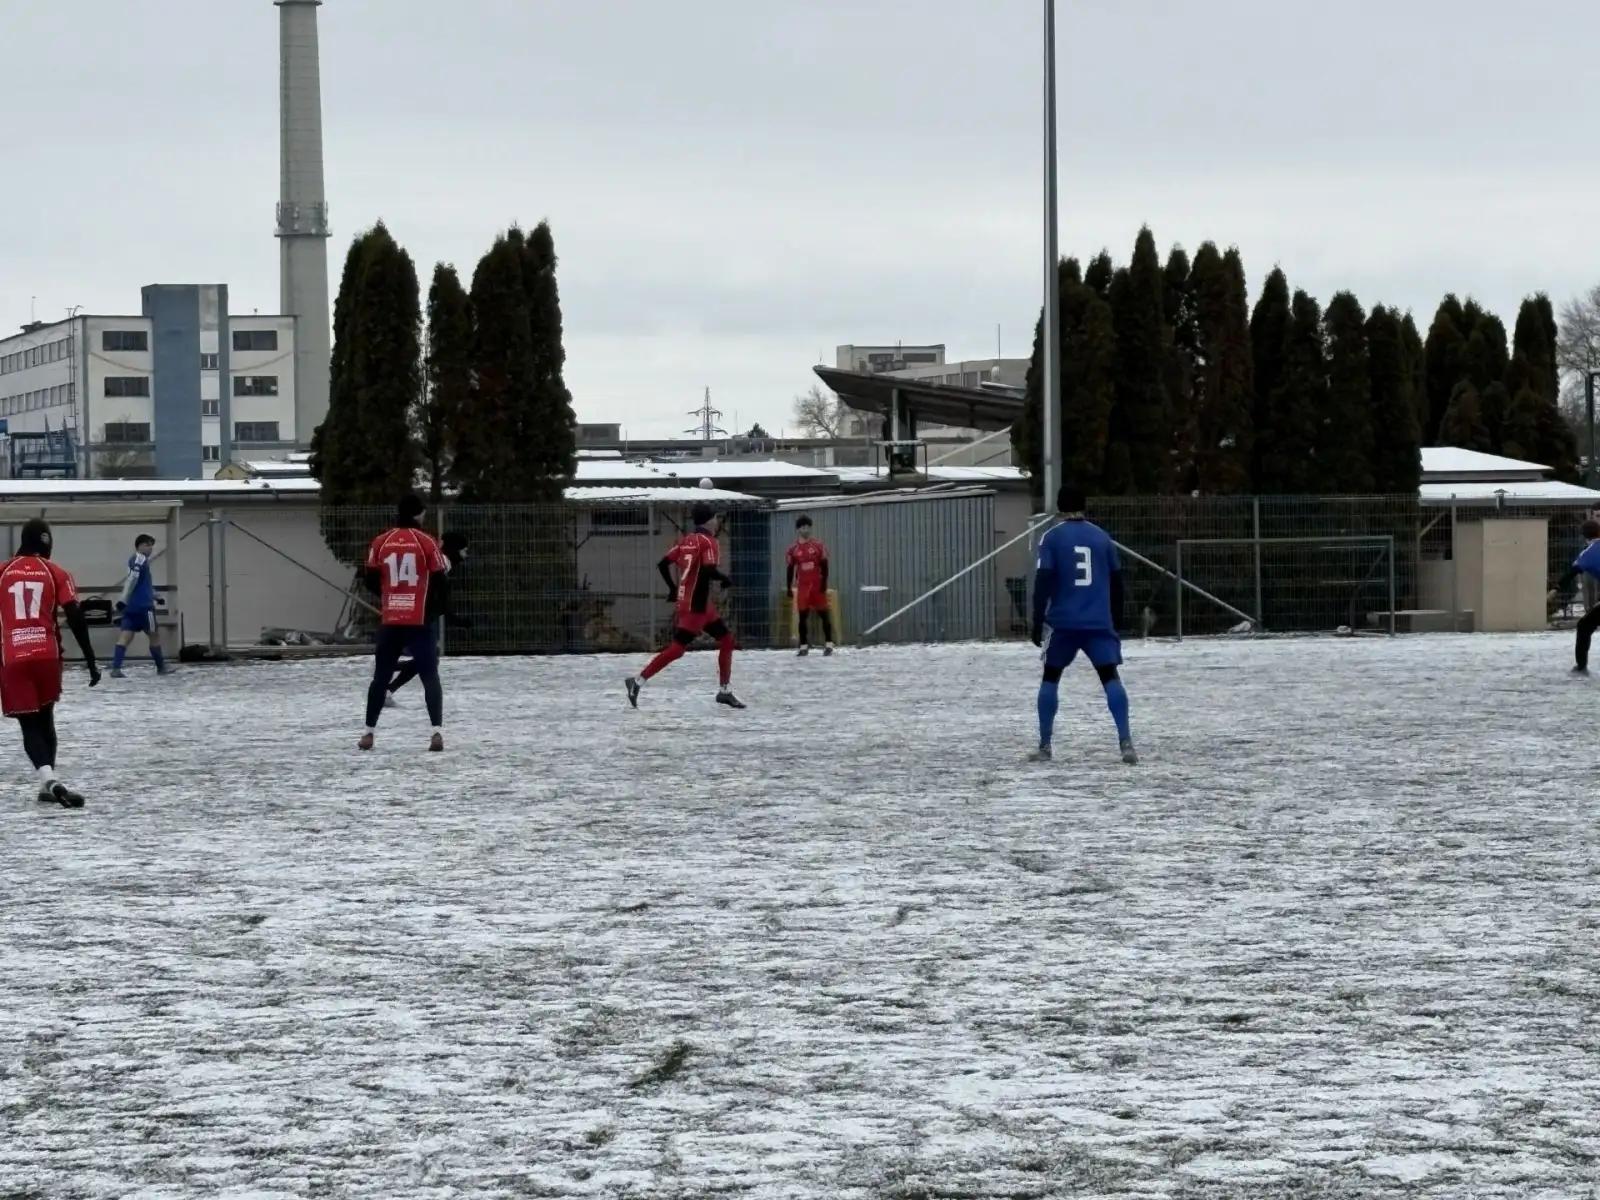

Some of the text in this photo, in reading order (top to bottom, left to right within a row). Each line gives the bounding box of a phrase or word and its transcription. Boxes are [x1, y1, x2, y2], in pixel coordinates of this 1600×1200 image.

[384, 552, 419, 587] 14
[681, 554, 693, 581] 7
[1074, 546, 1092, 586] 3
[8, 580, 44, 620] 17
